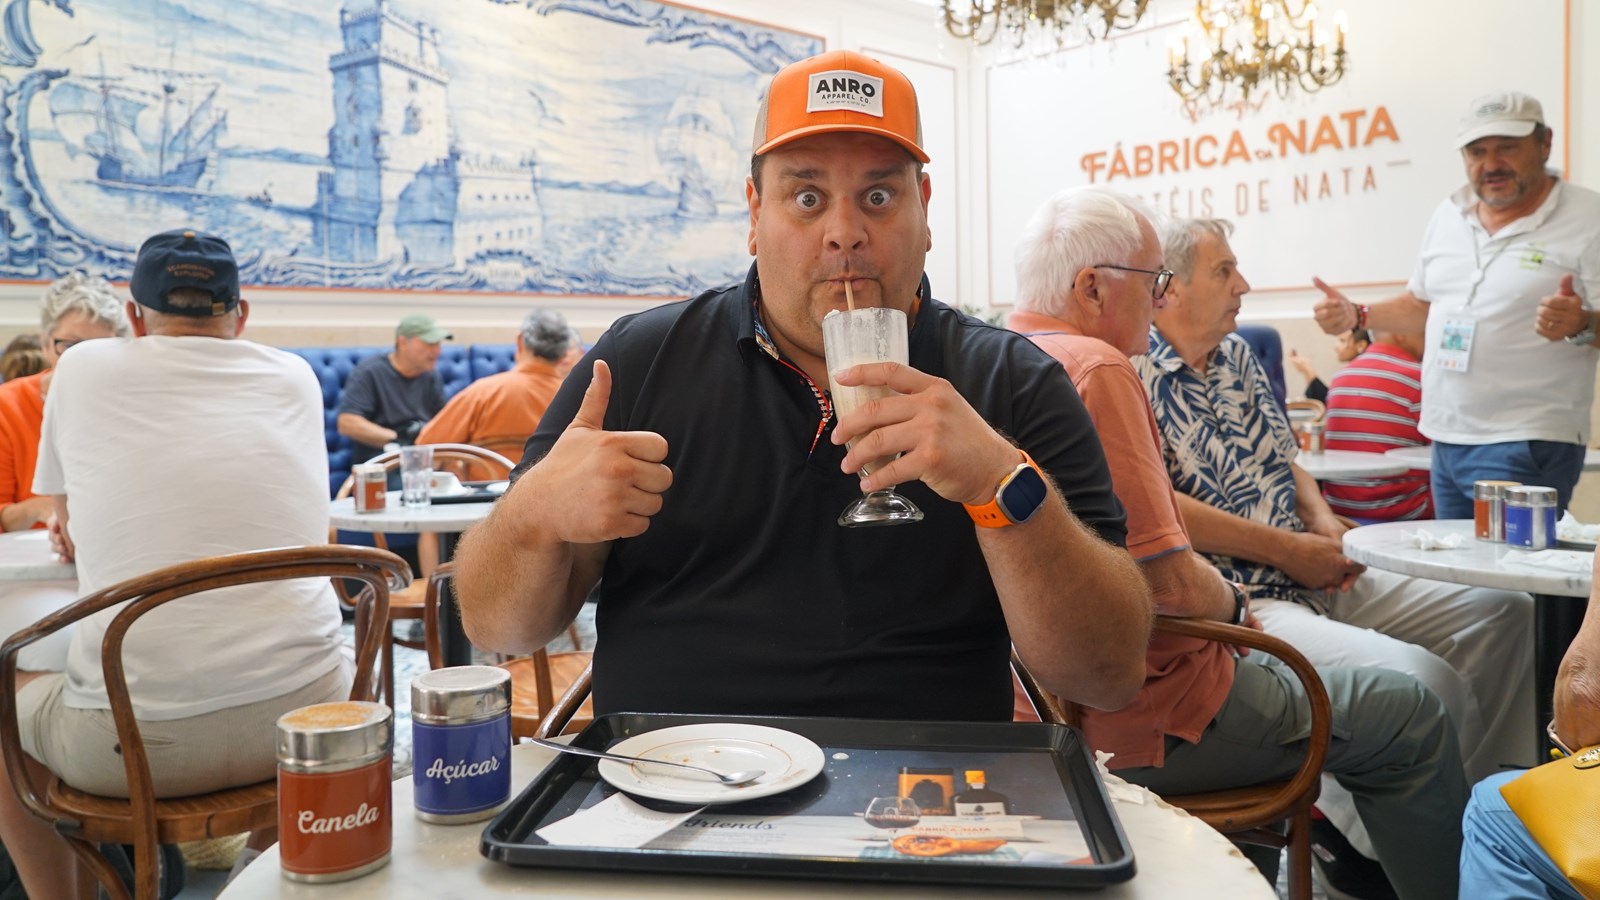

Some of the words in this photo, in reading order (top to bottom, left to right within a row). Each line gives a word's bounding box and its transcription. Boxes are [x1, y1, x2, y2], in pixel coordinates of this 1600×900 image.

[816, 78, 875, 97] ANRO
[1080, 129, 1252, 184] FÁBRICA
[1267, 105, 1400, 158] NATA
[1235, 179, 1270, 216] DE
[1293, 164, 1378, 206] NATA
[426, 755, 500, 784] Açúcar
[297, 802, 380, 834] Canela
[684, 818, 776, 830] Friends
